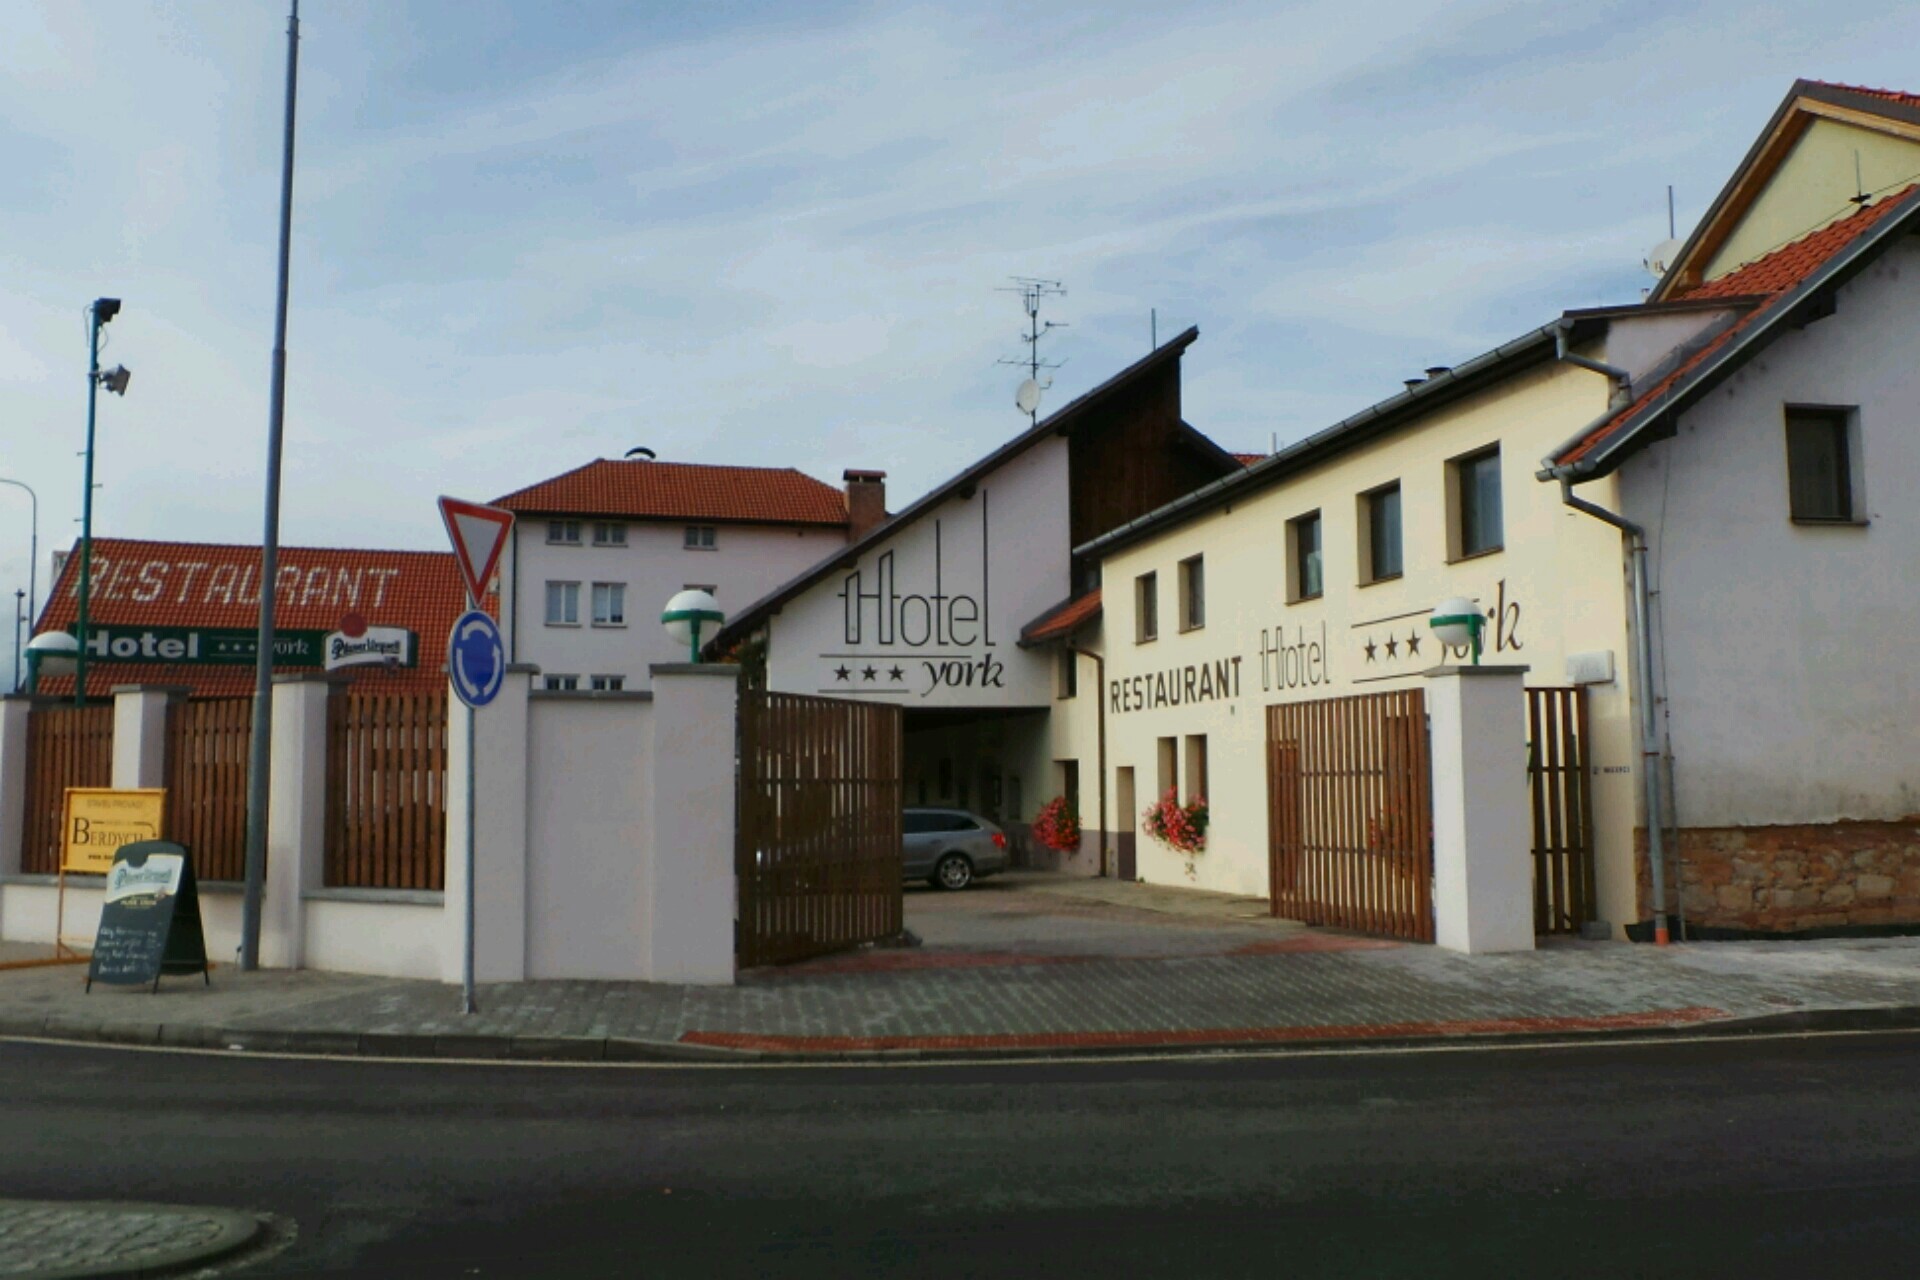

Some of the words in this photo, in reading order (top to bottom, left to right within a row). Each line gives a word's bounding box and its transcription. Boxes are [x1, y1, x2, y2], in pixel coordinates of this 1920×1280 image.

[837, 489, 996, 646] Hotel
[86, 630, 198, 659] Hotel
[1259, 620, 1331, 692] Hotel
[920, 653, 1006, 697] york
[1109, 655, 1242, 714] RESTAURANT
